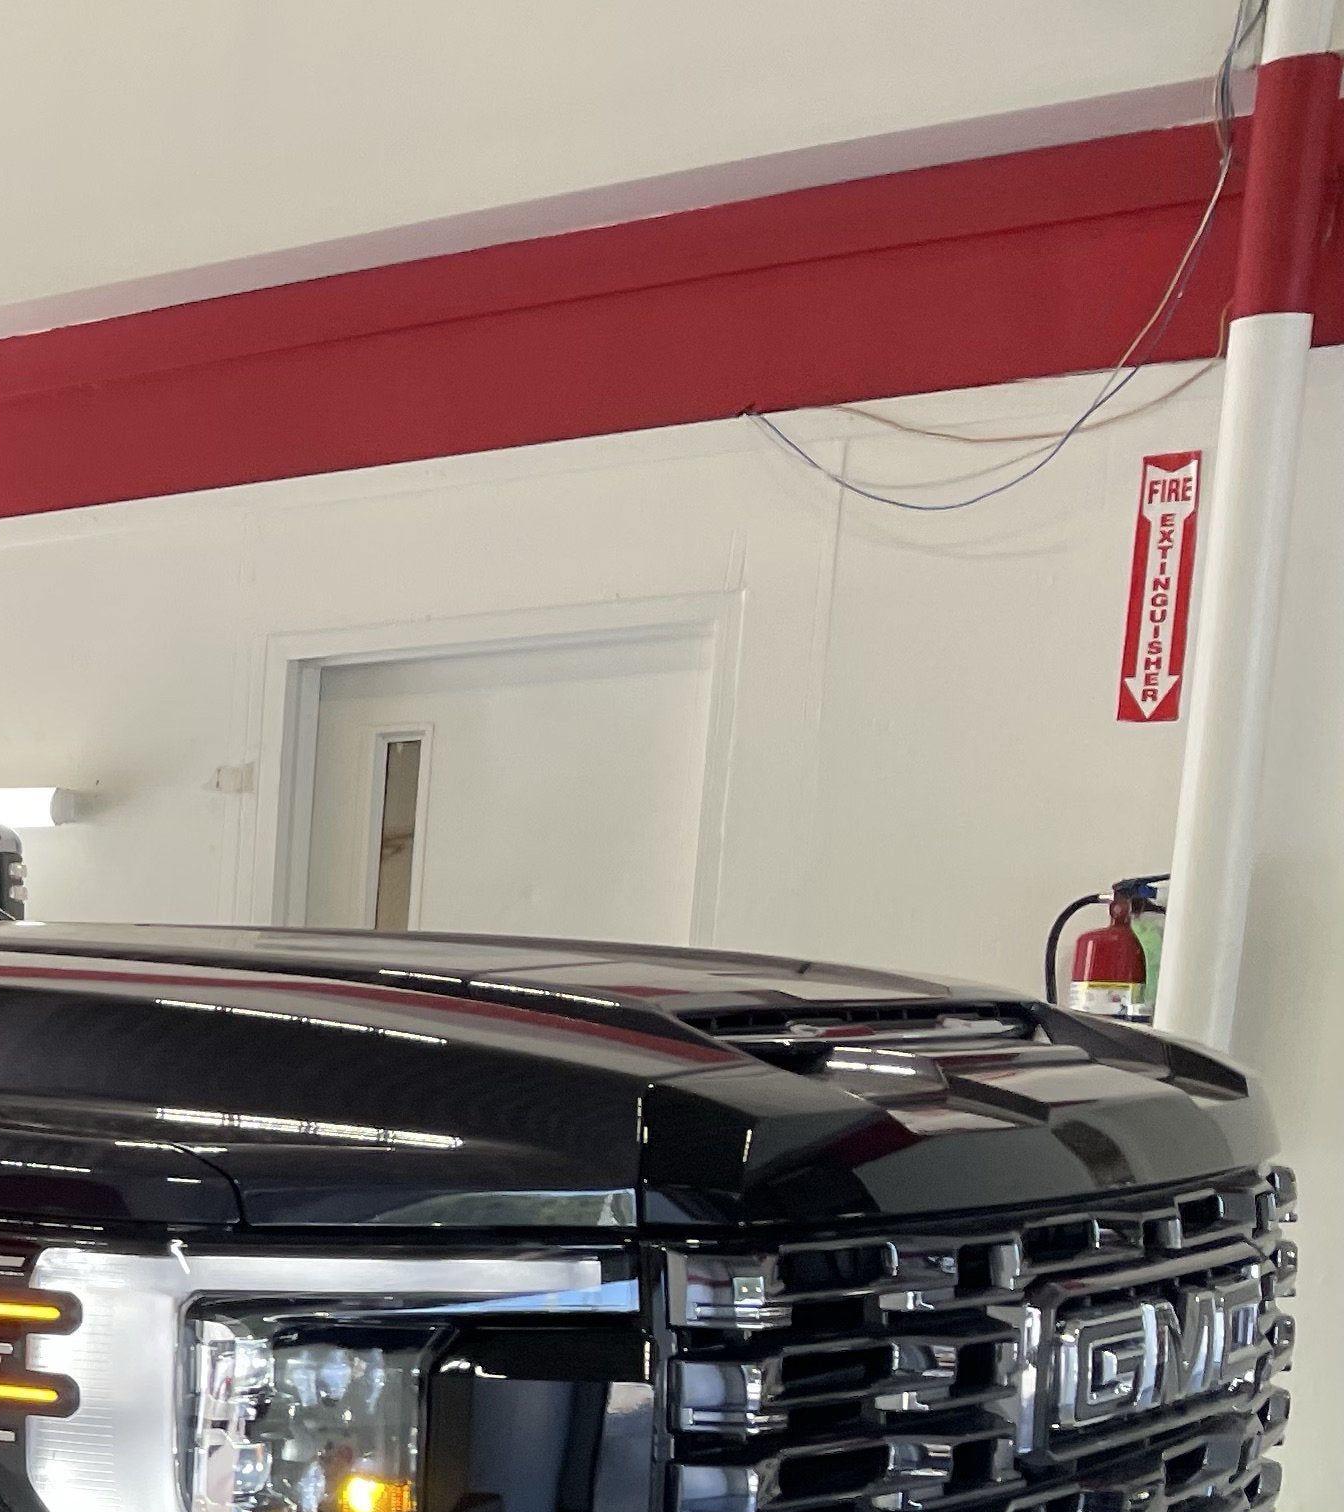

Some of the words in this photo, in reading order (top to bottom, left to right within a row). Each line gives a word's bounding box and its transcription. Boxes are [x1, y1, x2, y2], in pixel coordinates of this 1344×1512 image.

[1148, 477, 1193, 504] FIRE
[1141, 513, 1175, 702] EXTINGUISHER
[1054, 1277, 1264, 1429] GMC
